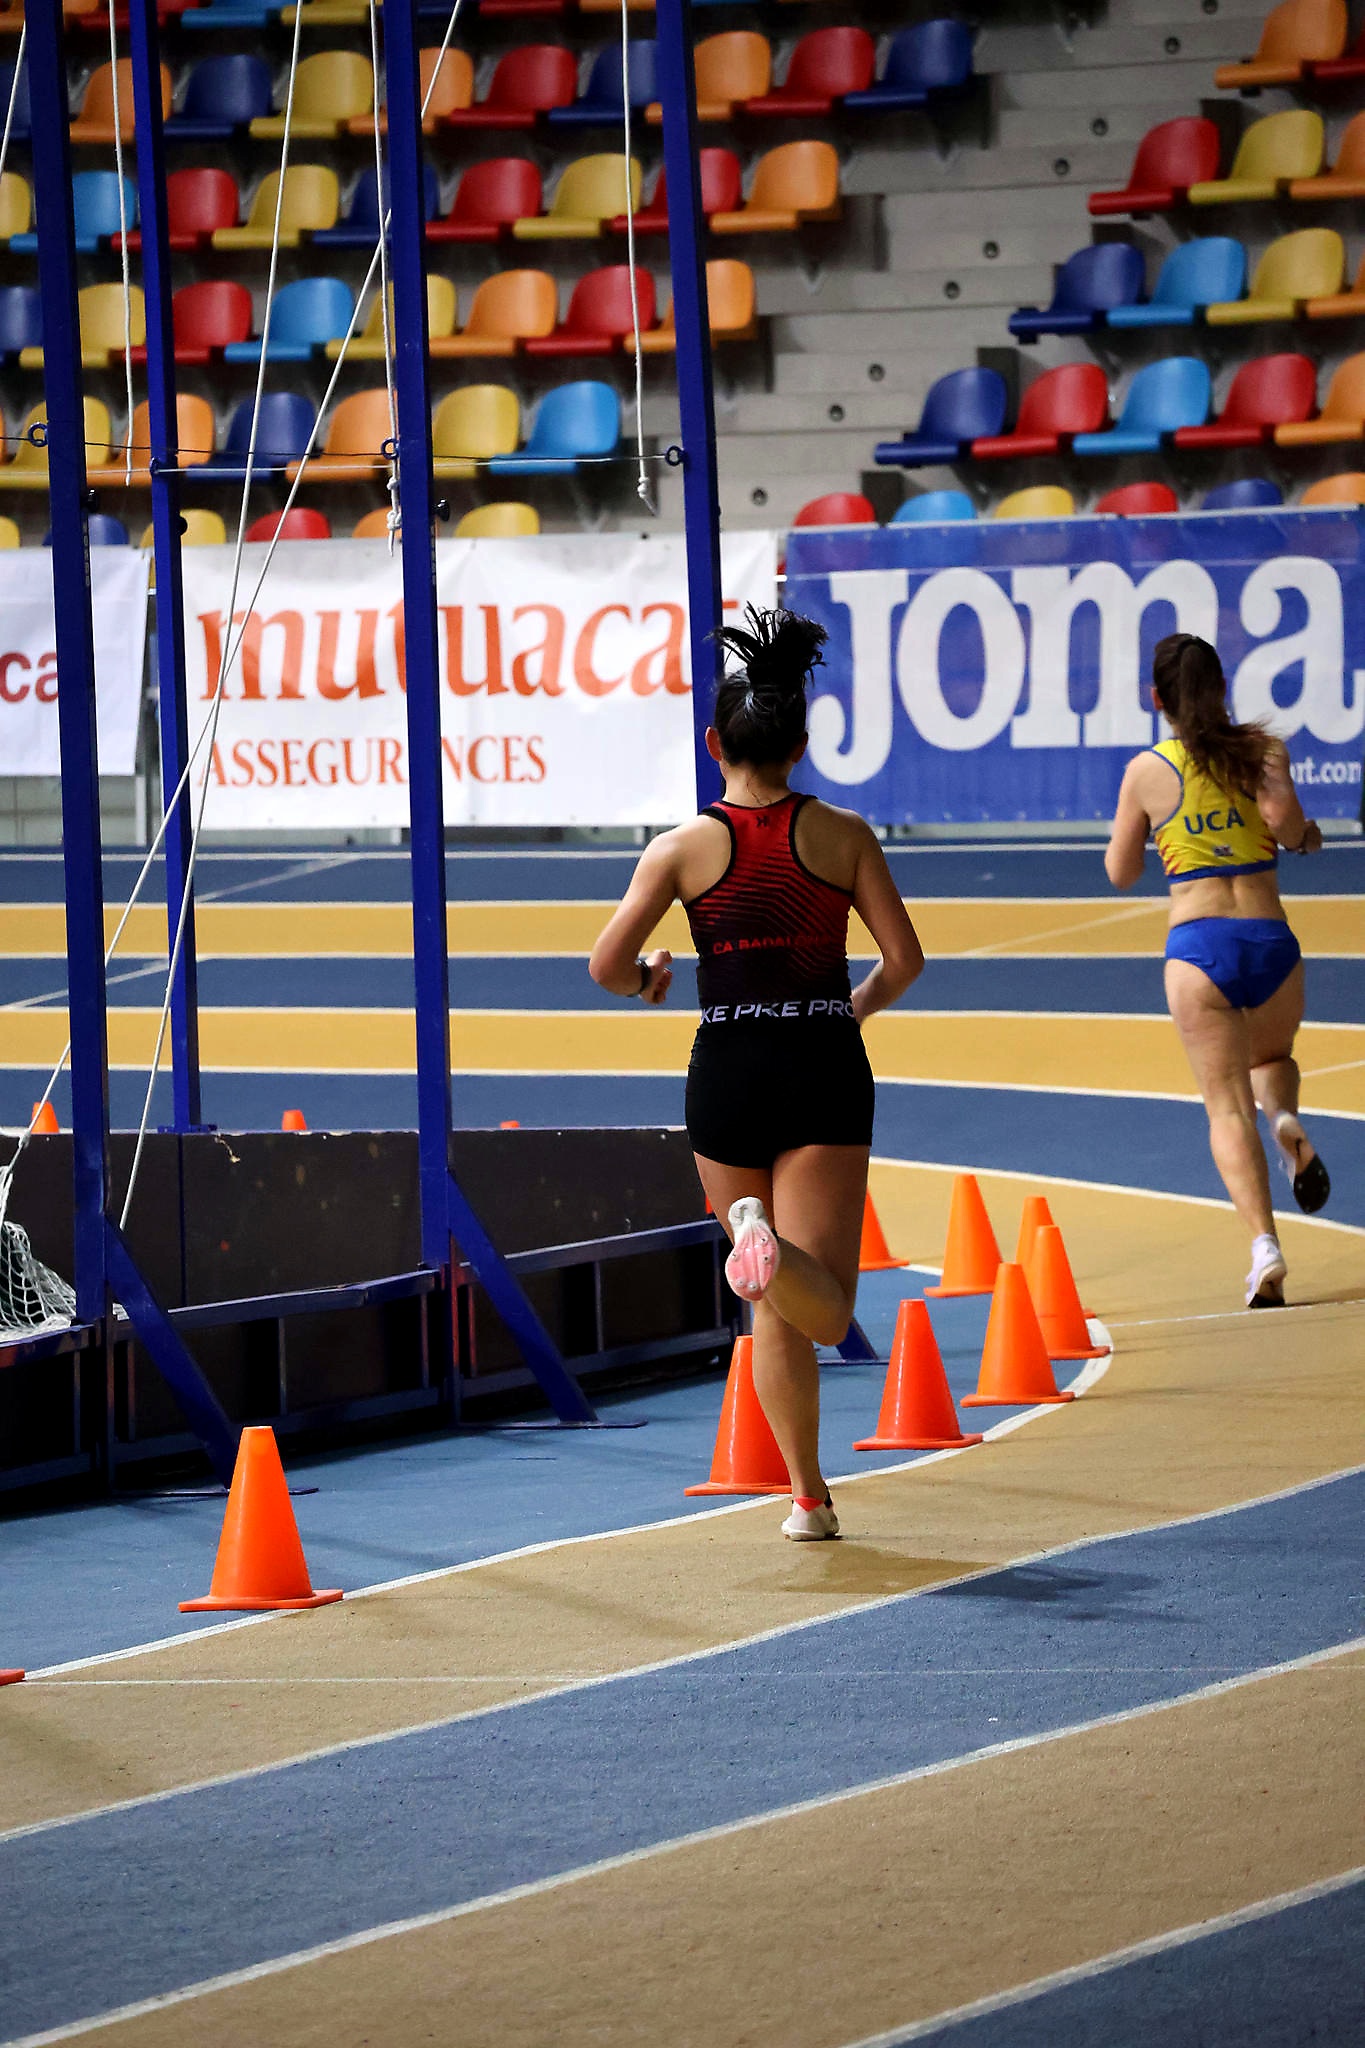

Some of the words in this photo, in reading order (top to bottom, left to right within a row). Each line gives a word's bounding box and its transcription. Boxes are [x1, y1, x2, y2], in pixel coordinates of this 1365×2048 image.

[197, 598, 738, 701] muuaca
[198, 734, 547, 787] ASSEGURNCES
[1184, 807, 1245, 835] UCA
[712, 939, 733, 955] CA
